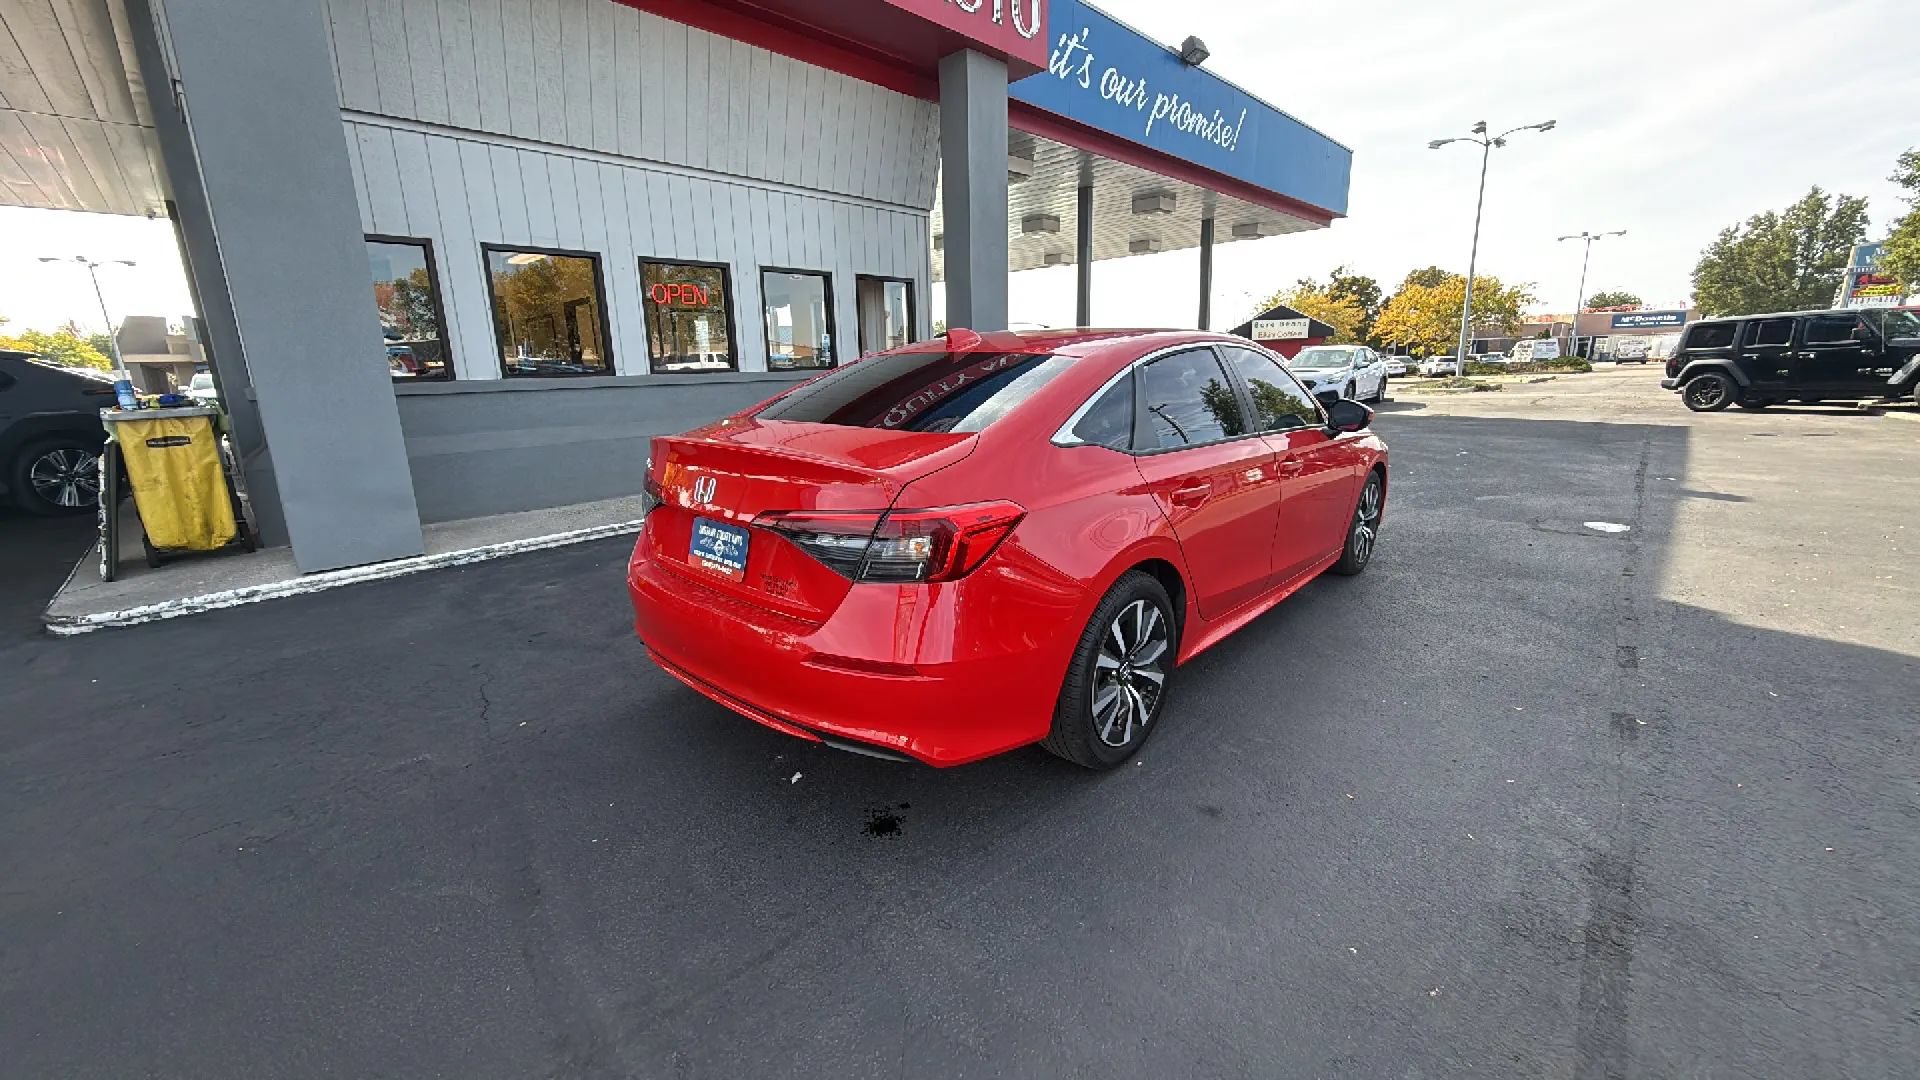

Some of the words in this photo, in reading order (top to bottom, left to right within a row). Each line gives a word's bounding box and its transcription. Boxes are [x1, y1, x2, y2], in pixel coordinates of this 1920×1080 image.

[1050, 27, 1095, 89] it's
[1100, 67, 1149, 112] our
[1146, 93, 1247, 151] promise!
[651, 283, 708, 305] OPEN
